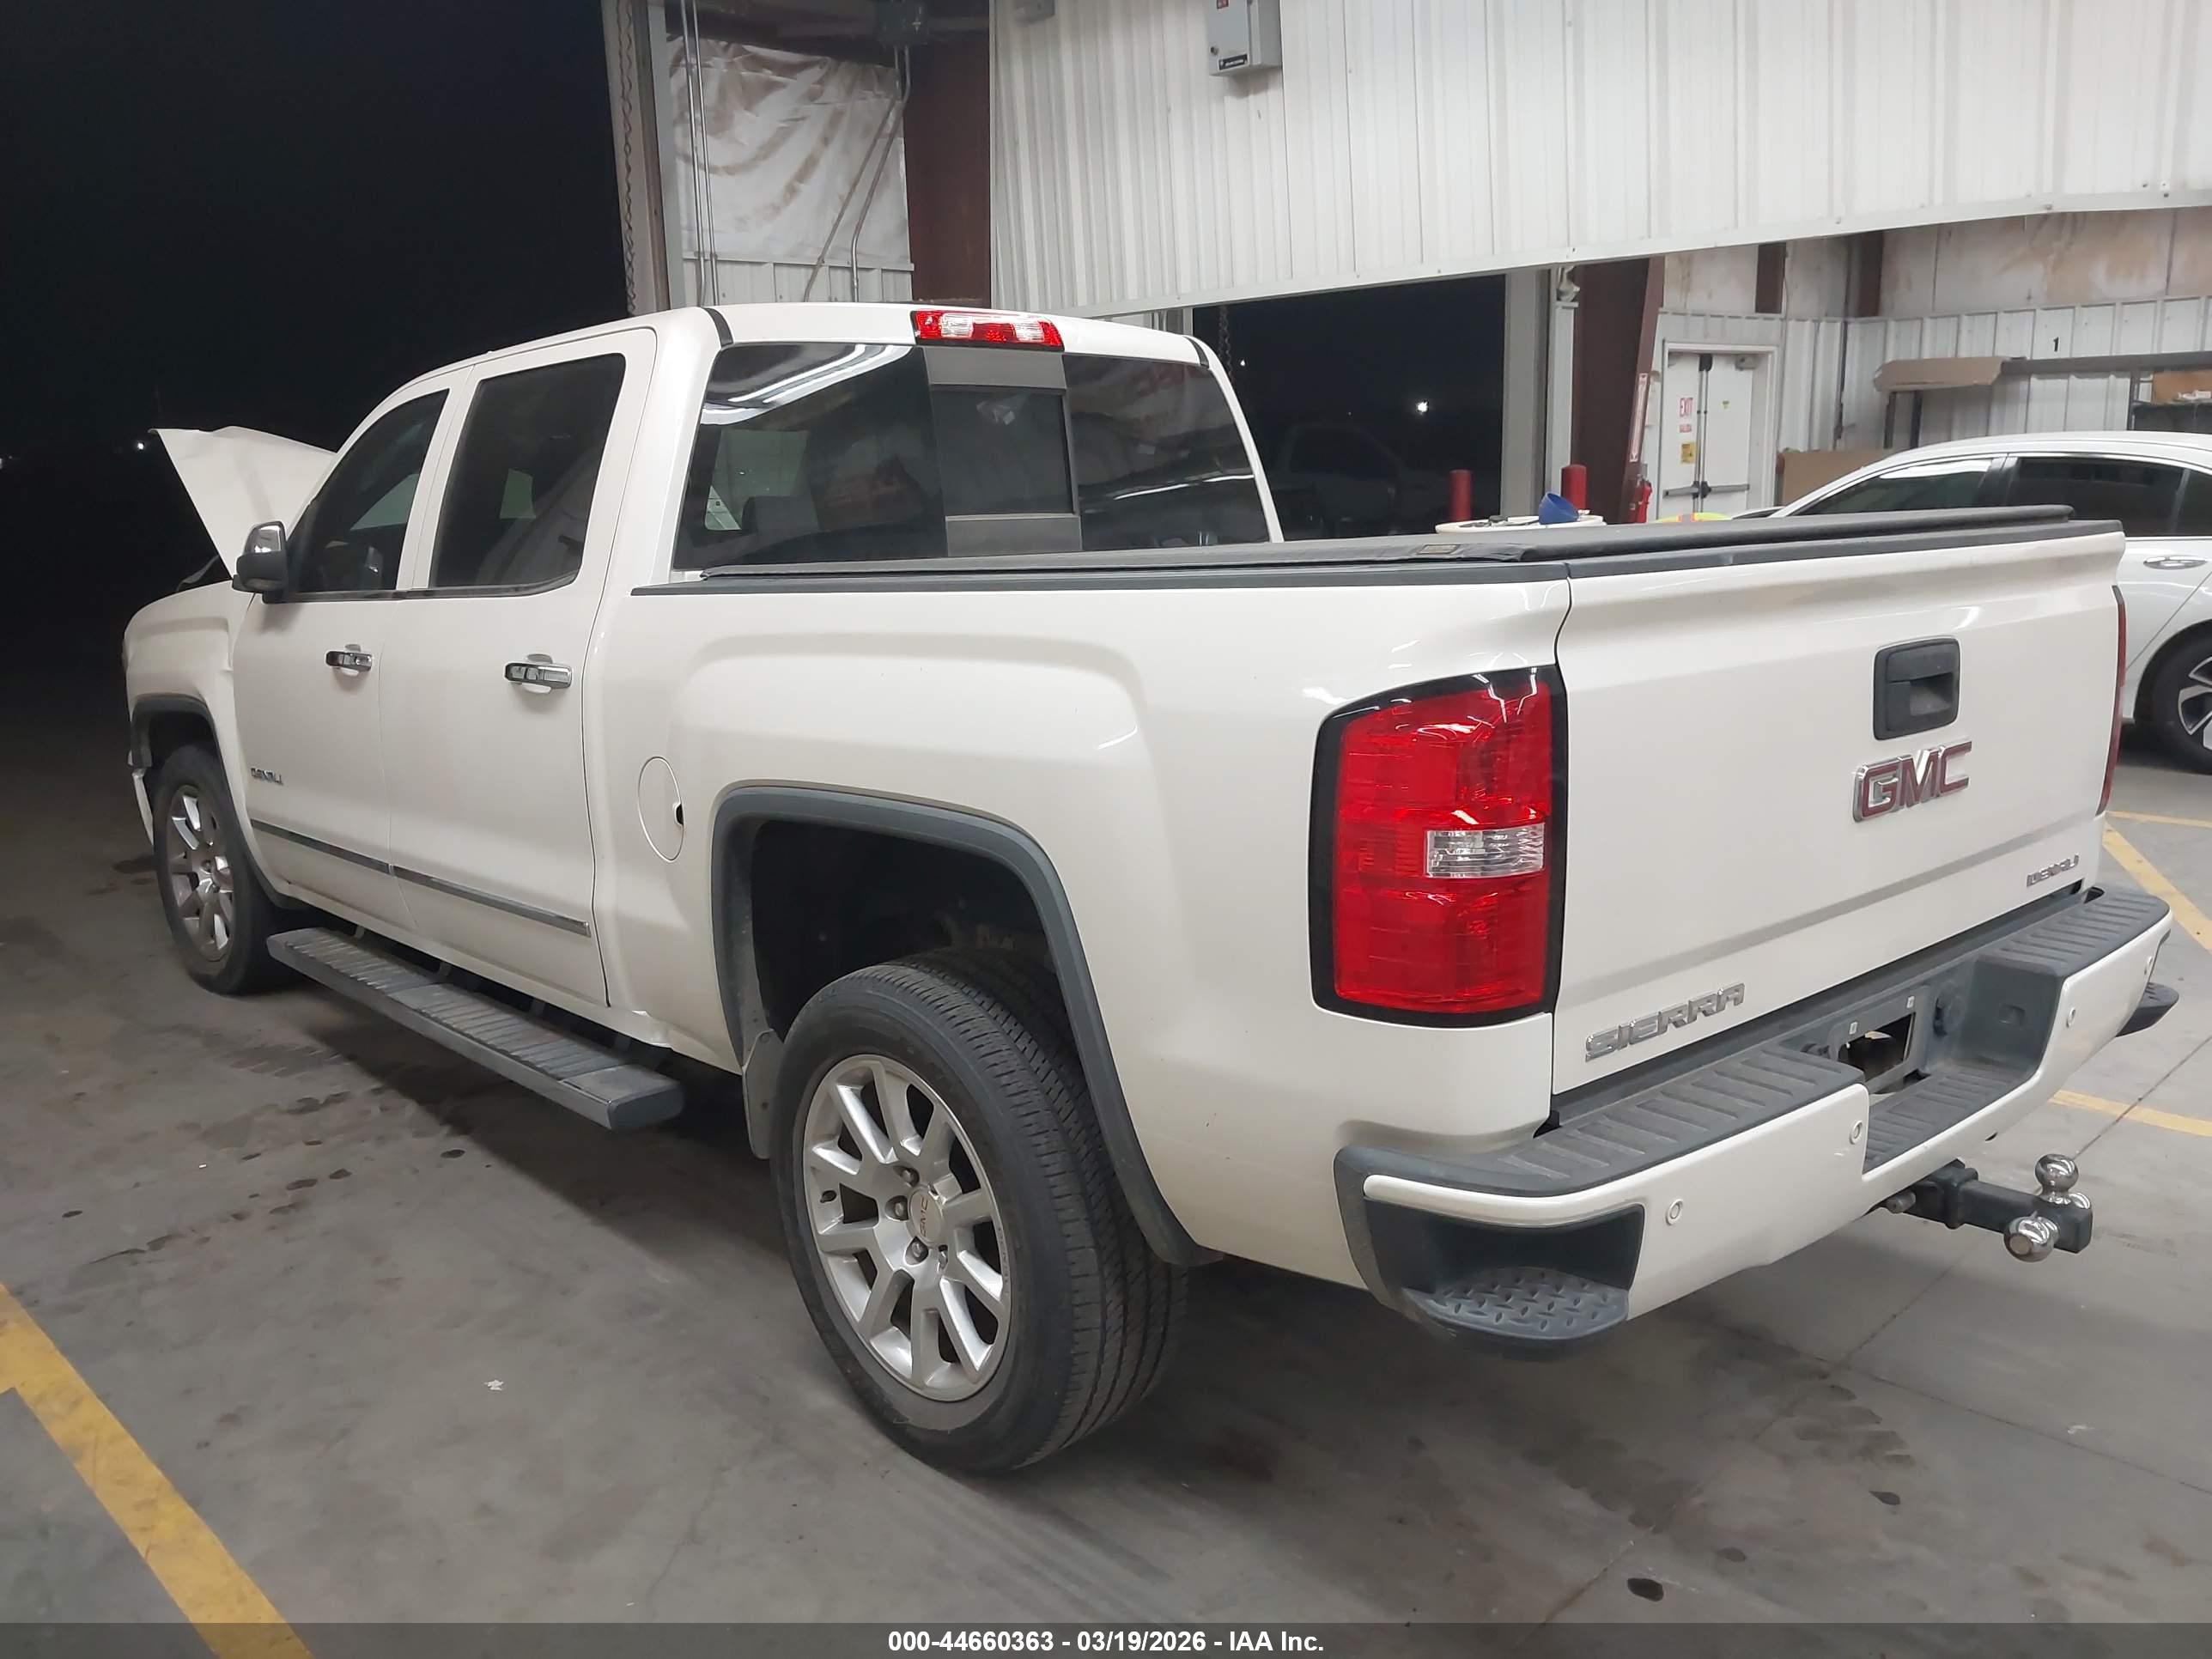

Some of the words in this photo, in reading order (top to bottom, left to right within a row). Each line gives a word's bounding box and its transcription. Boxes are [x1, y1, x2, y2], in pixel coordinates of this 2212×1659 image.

[2053, 337, 2059, 352] 1
[1853, 739, 1972, 823] GMC
[1585, 982, 1746, 1062] SIERRA
[920, 1196, 928, 1237] GMC
